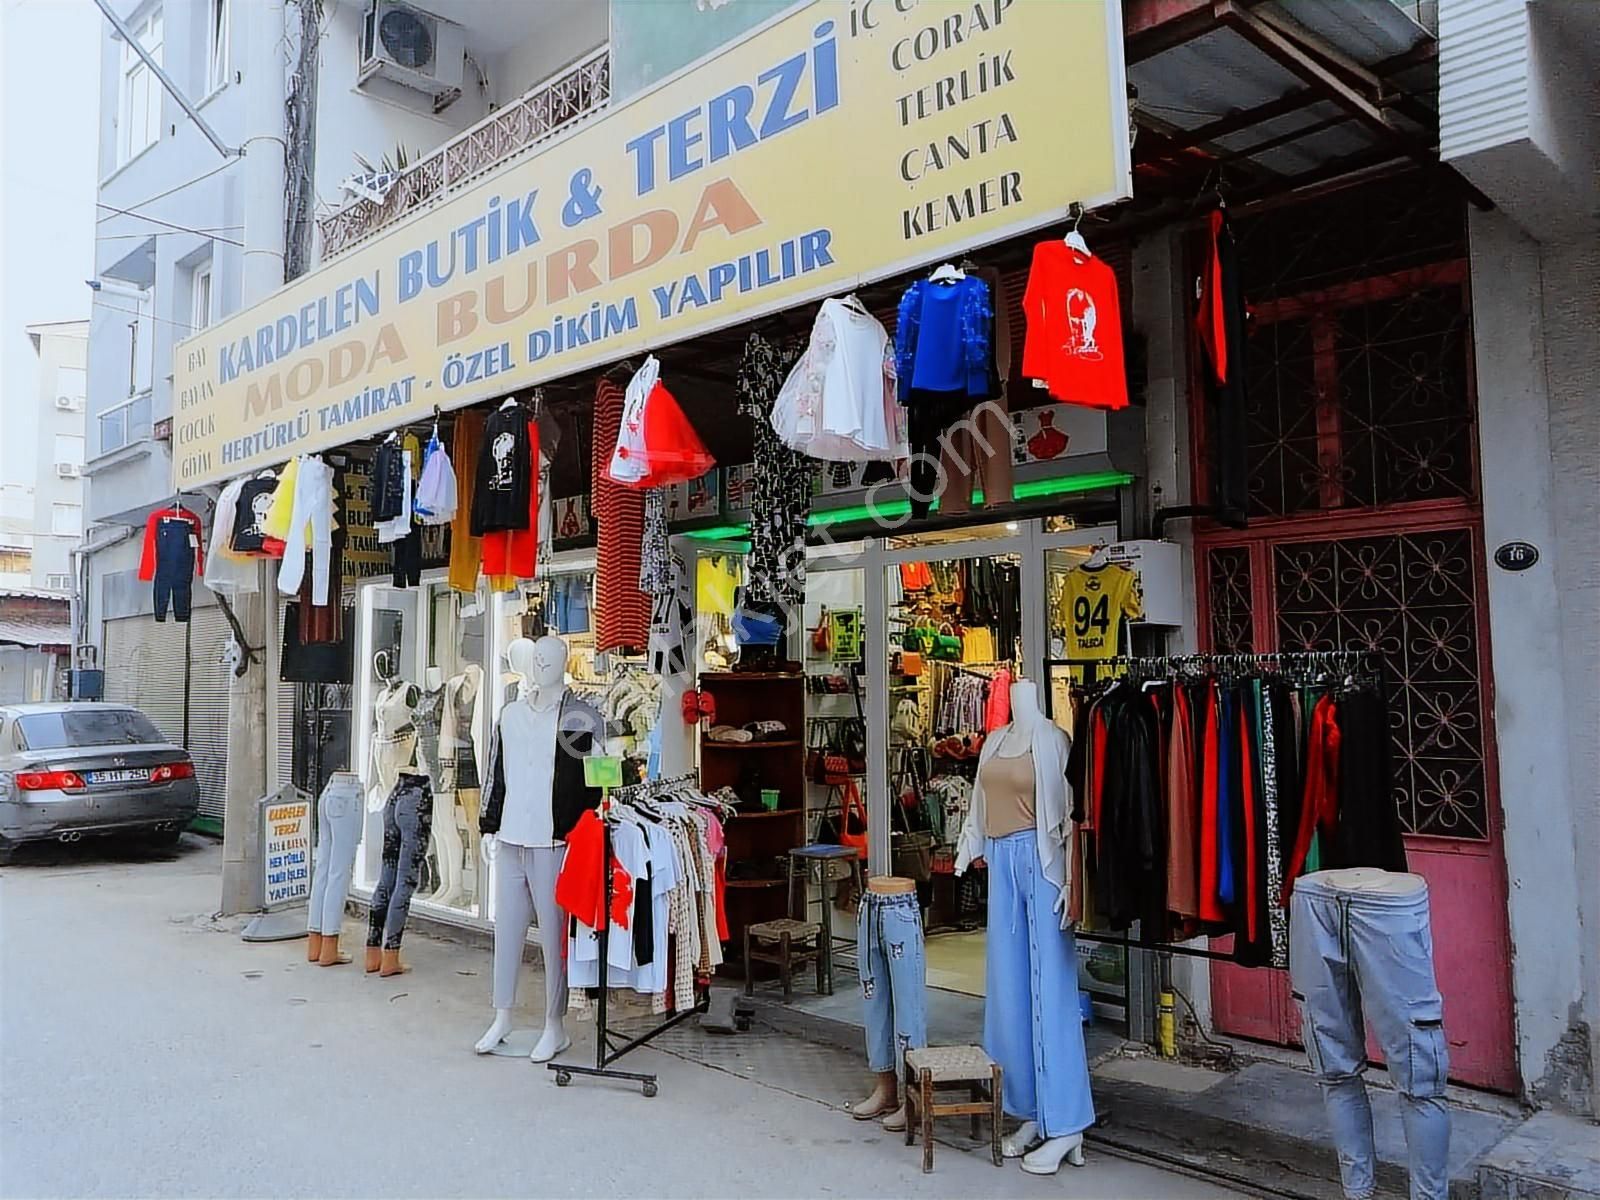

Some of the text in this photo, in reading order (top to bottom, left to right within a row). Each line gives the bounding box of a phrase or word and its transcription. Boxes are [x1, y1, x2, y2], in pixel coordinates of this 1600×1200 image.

[892, 0, 1015, 79] ÇORAP
[896, 49, 1015, 126] TERLİK
[900, 113, 1019, 190] ÇANTA
[219, 19, 840, 386] KARDELEN BUTİK & TERZİ
[903, 170, 1023, 240] KEMER
[243, 177, 763, 424] MODA BURDA
[188, 346, 206, 373] BAY
[221, 409, 311, 465] HERTÜRLÜ
[317, 376, 417, 431] TAMİRAT
[443, 341, 516, 390] ÖZEL
[528, 297, 640, 363] DİKİM
[652, 228, 836, 321] YAPILIR
[1074, 593, 1110, 637] 94
[268, 884, 307, 902] YAPILIR
